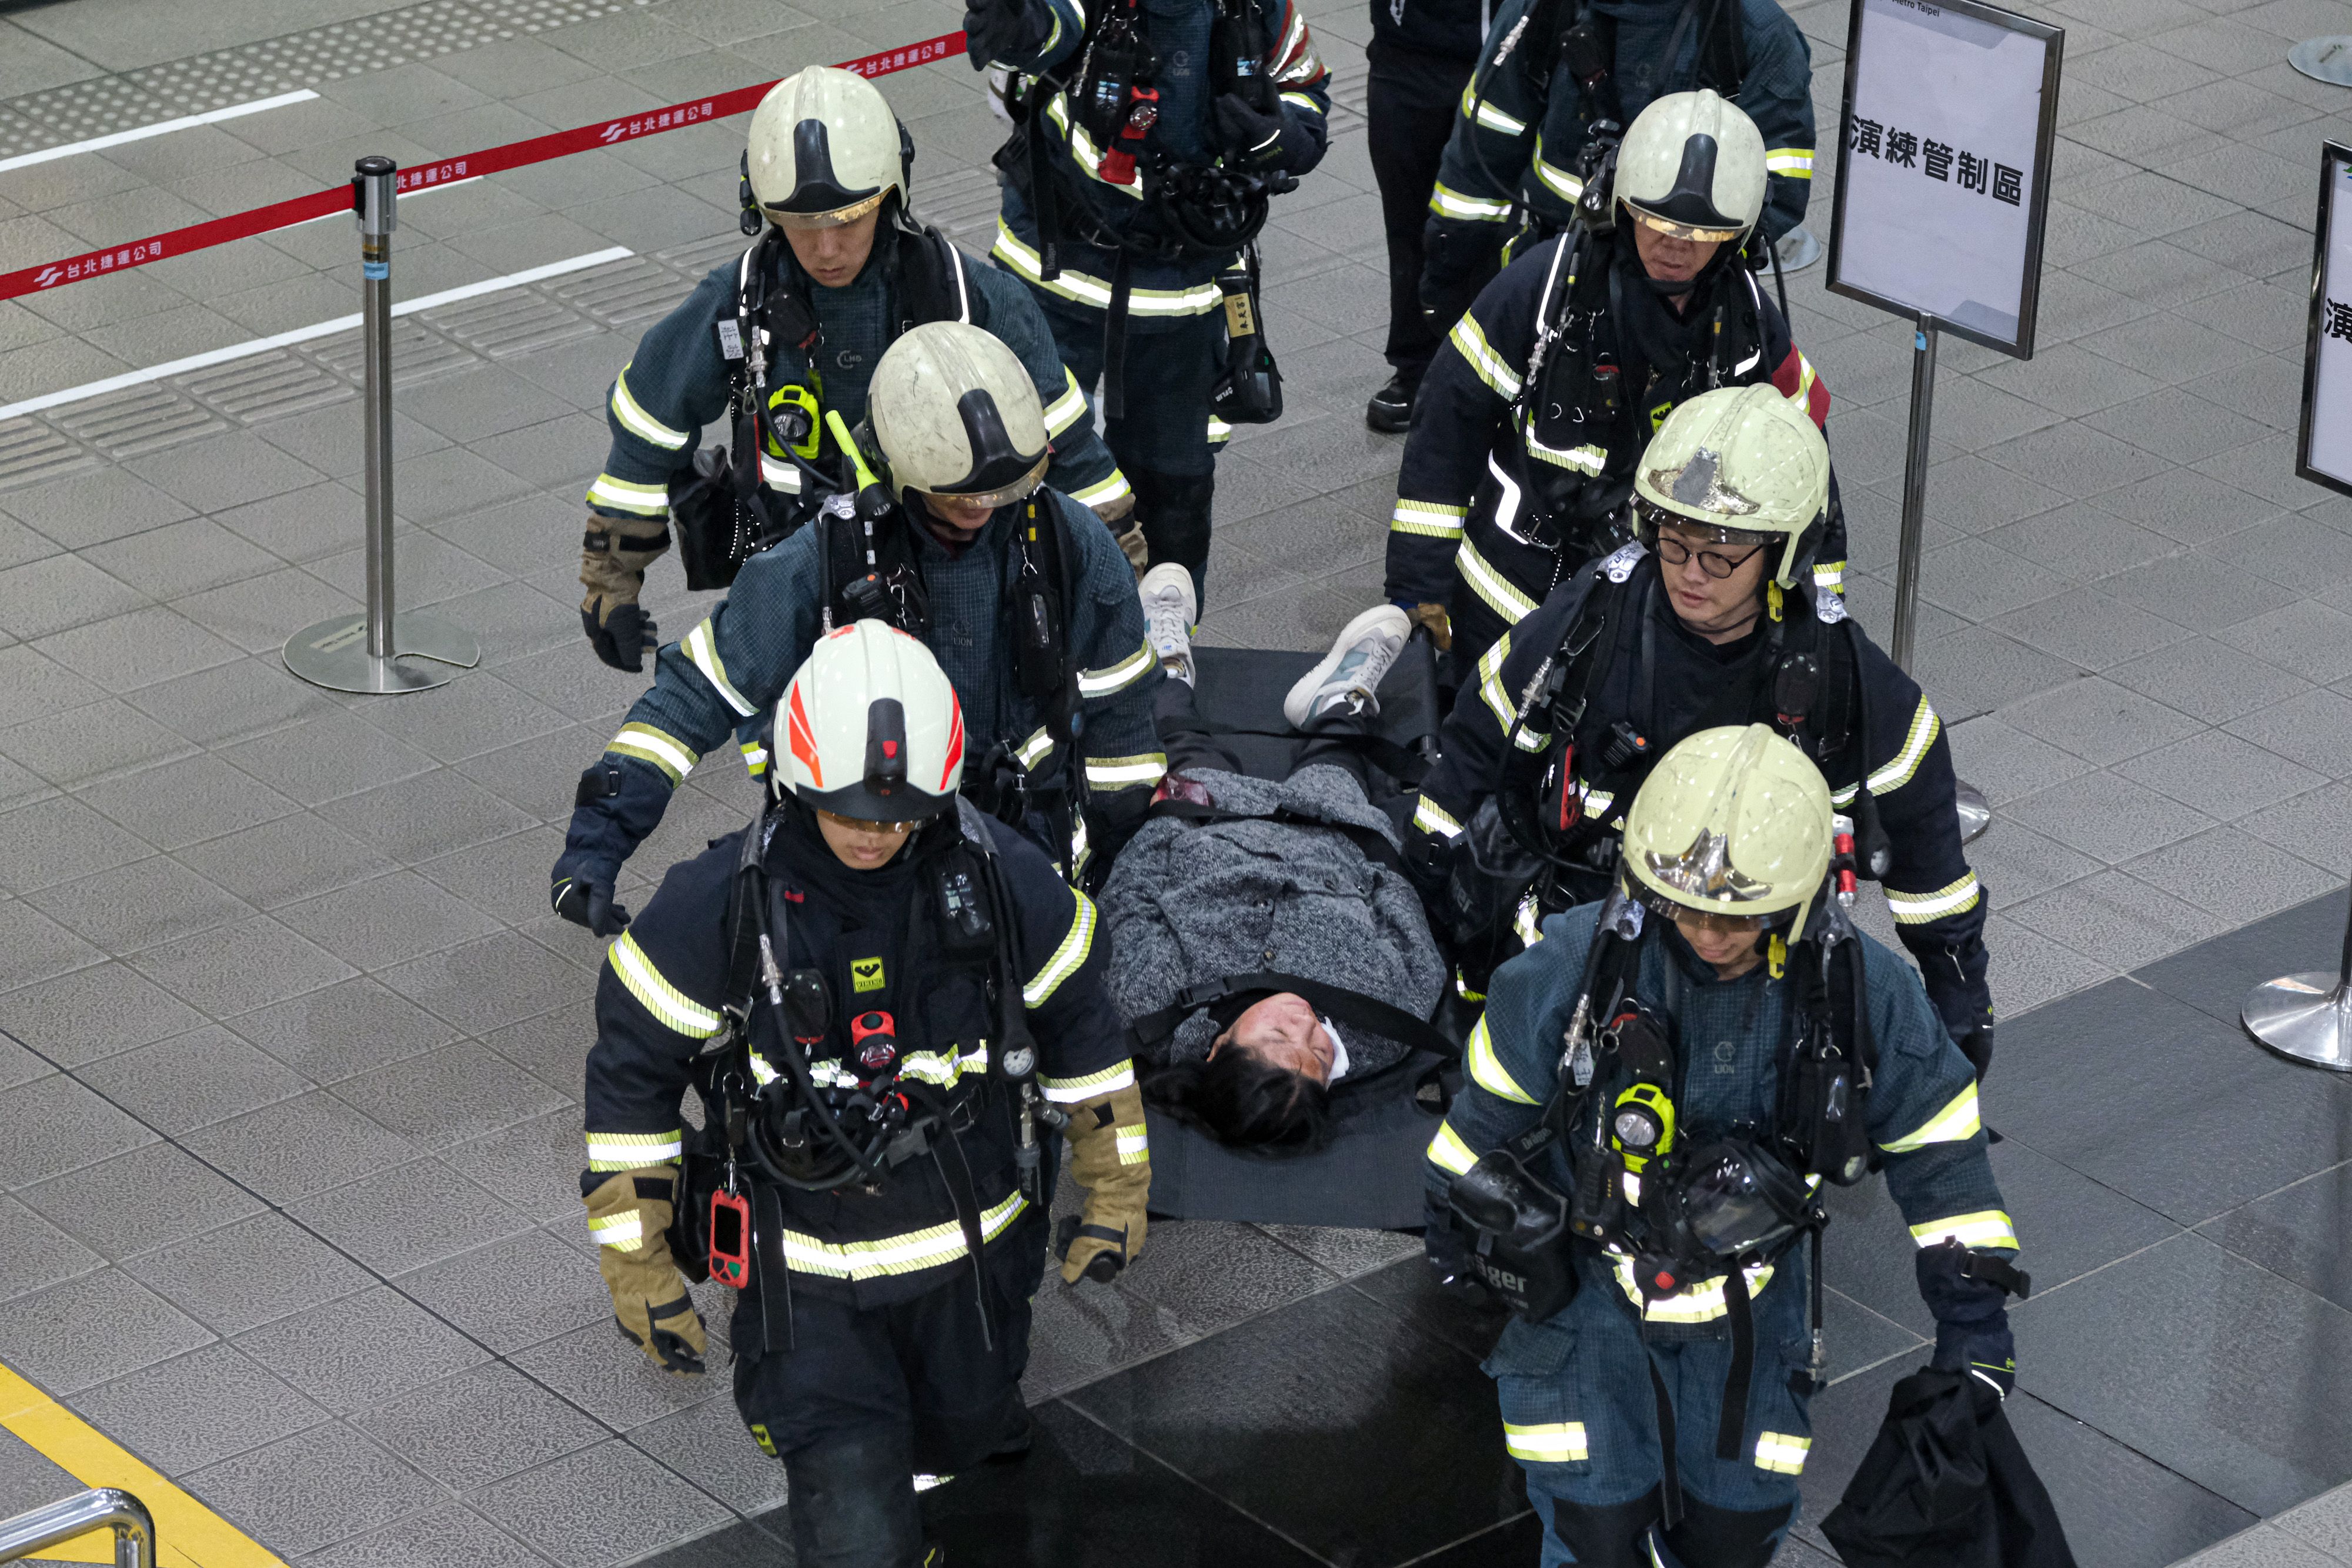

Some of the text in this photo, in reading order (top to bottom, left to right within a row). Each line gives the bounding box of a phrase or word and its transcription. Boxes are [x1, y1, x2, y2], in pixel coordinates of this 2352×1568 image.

[1917, 2, 1940, 17] Taipei
[866, 41, 946, 75] 台北捷運公司
[630, 102, 713, 135] 台北捷運公司
[1849, 115, 2023, 206] 演練管制區
[67, 241, 162, 279] 台北捷運公司
